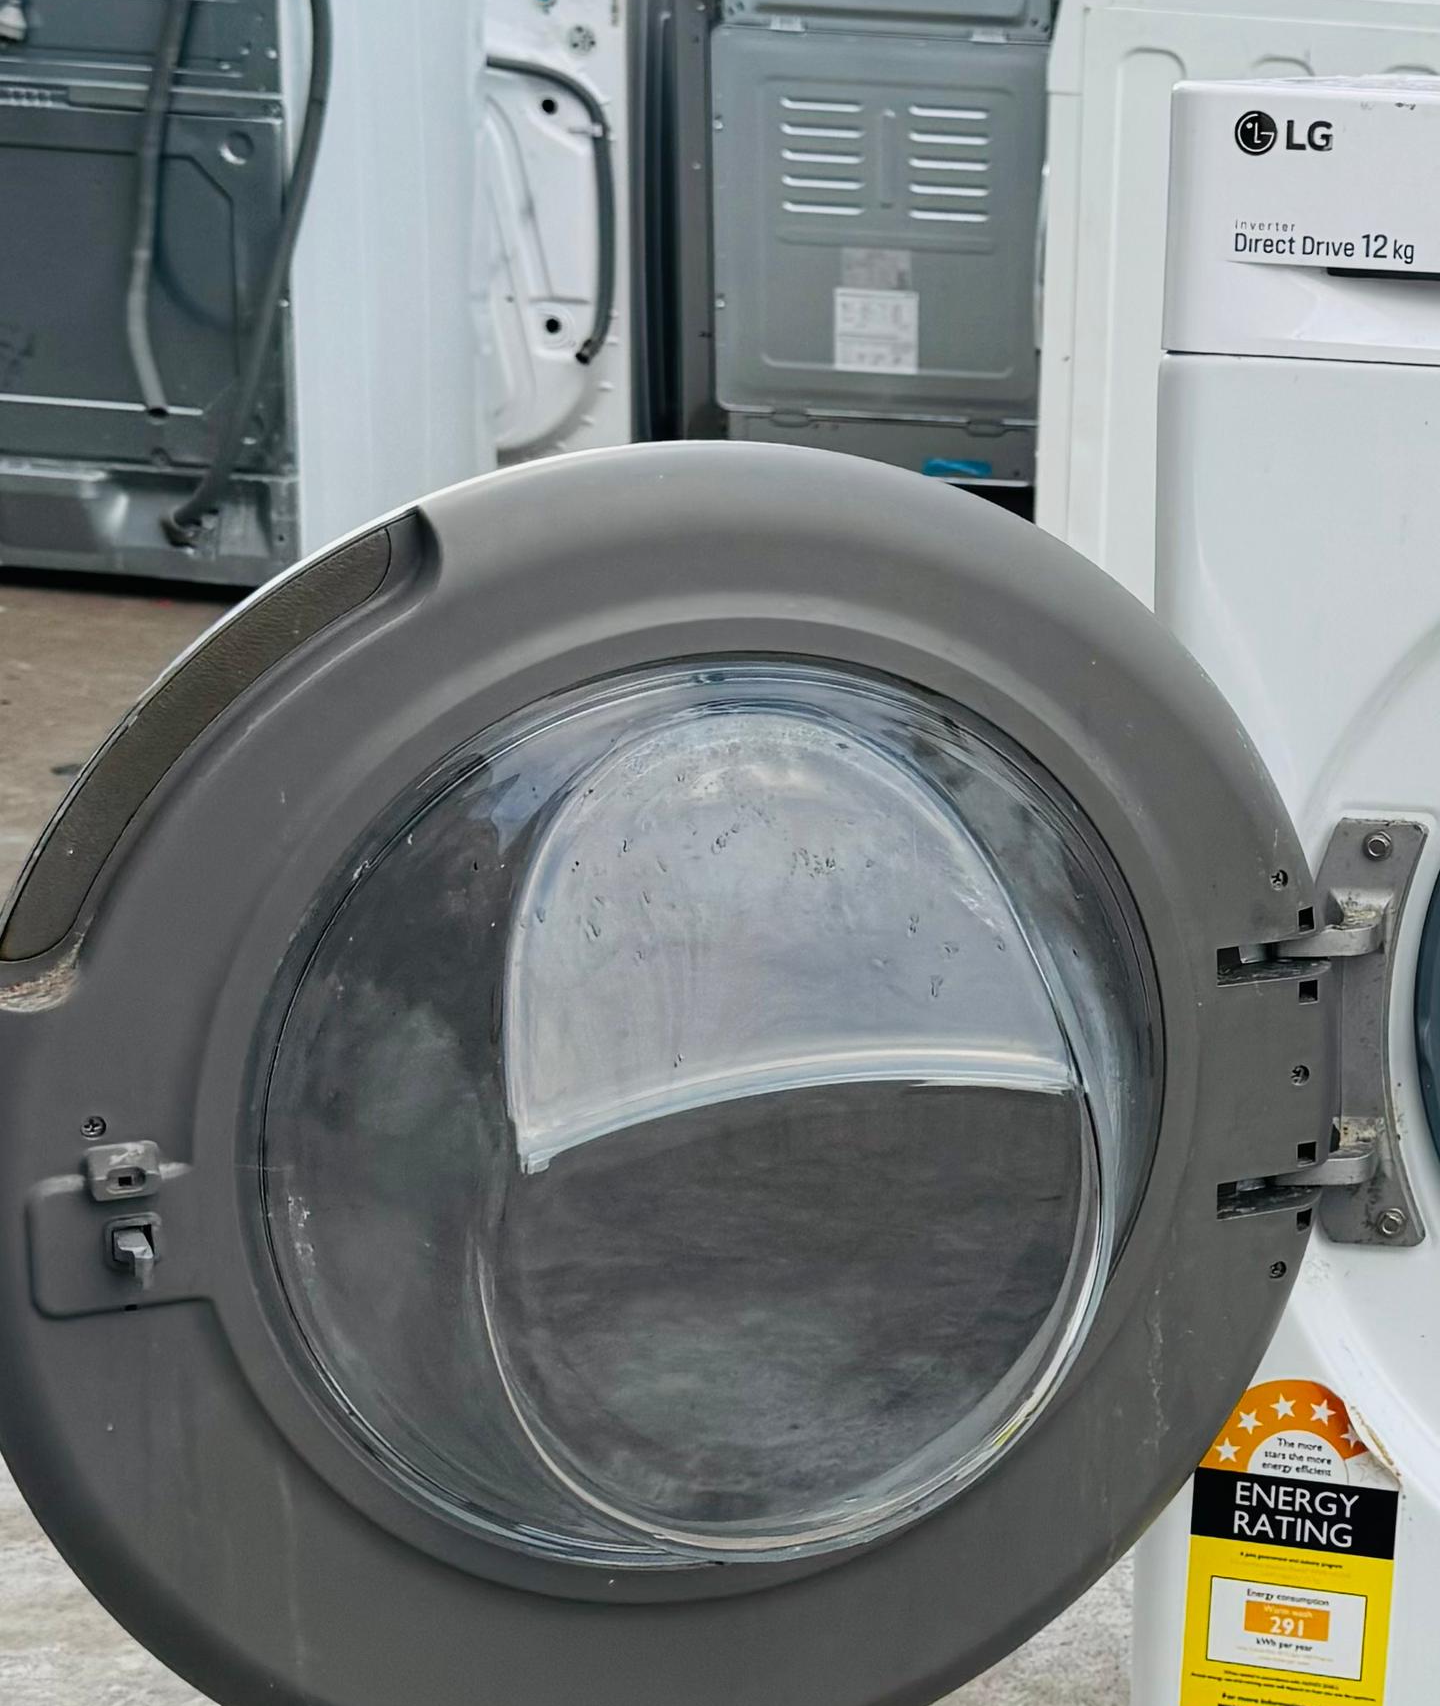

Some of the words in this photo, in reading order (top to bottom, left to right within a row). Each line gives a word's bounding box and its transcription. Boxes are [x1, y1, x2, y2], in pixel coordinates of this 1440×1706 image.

[1285, 119, 1333, 151] LG
[1234, 232, 1295, 255] Direct
[1302, 234, 1355, 258] Drive
[1362, 233, 1388, 258] 12
[1392, 239, 1416, 263] kg
[1277, 1437, 1295, 1448] The
[1297, 1442, 1323, 1452] more
[1264, 1450, 1286, 1460] stars
[1288, 1452, 1304, 1462] the
[1306, 1455, 1332, 1465] more
[1261, 1461, 1293, 1474] energy
[1295, 1464, 1332, 1476] efficient
[1235, 1481, 1359, 1518] ENERGY
[1233, 1510, 1353, 1548] RATING
[1247, 1588, 1274, 1601] Energy
[1276, 1594, 1330, 1606] consumption
[1270, 1615, 1304, 1637] 291
[1256, 1637, 1276, 1647] kWh
